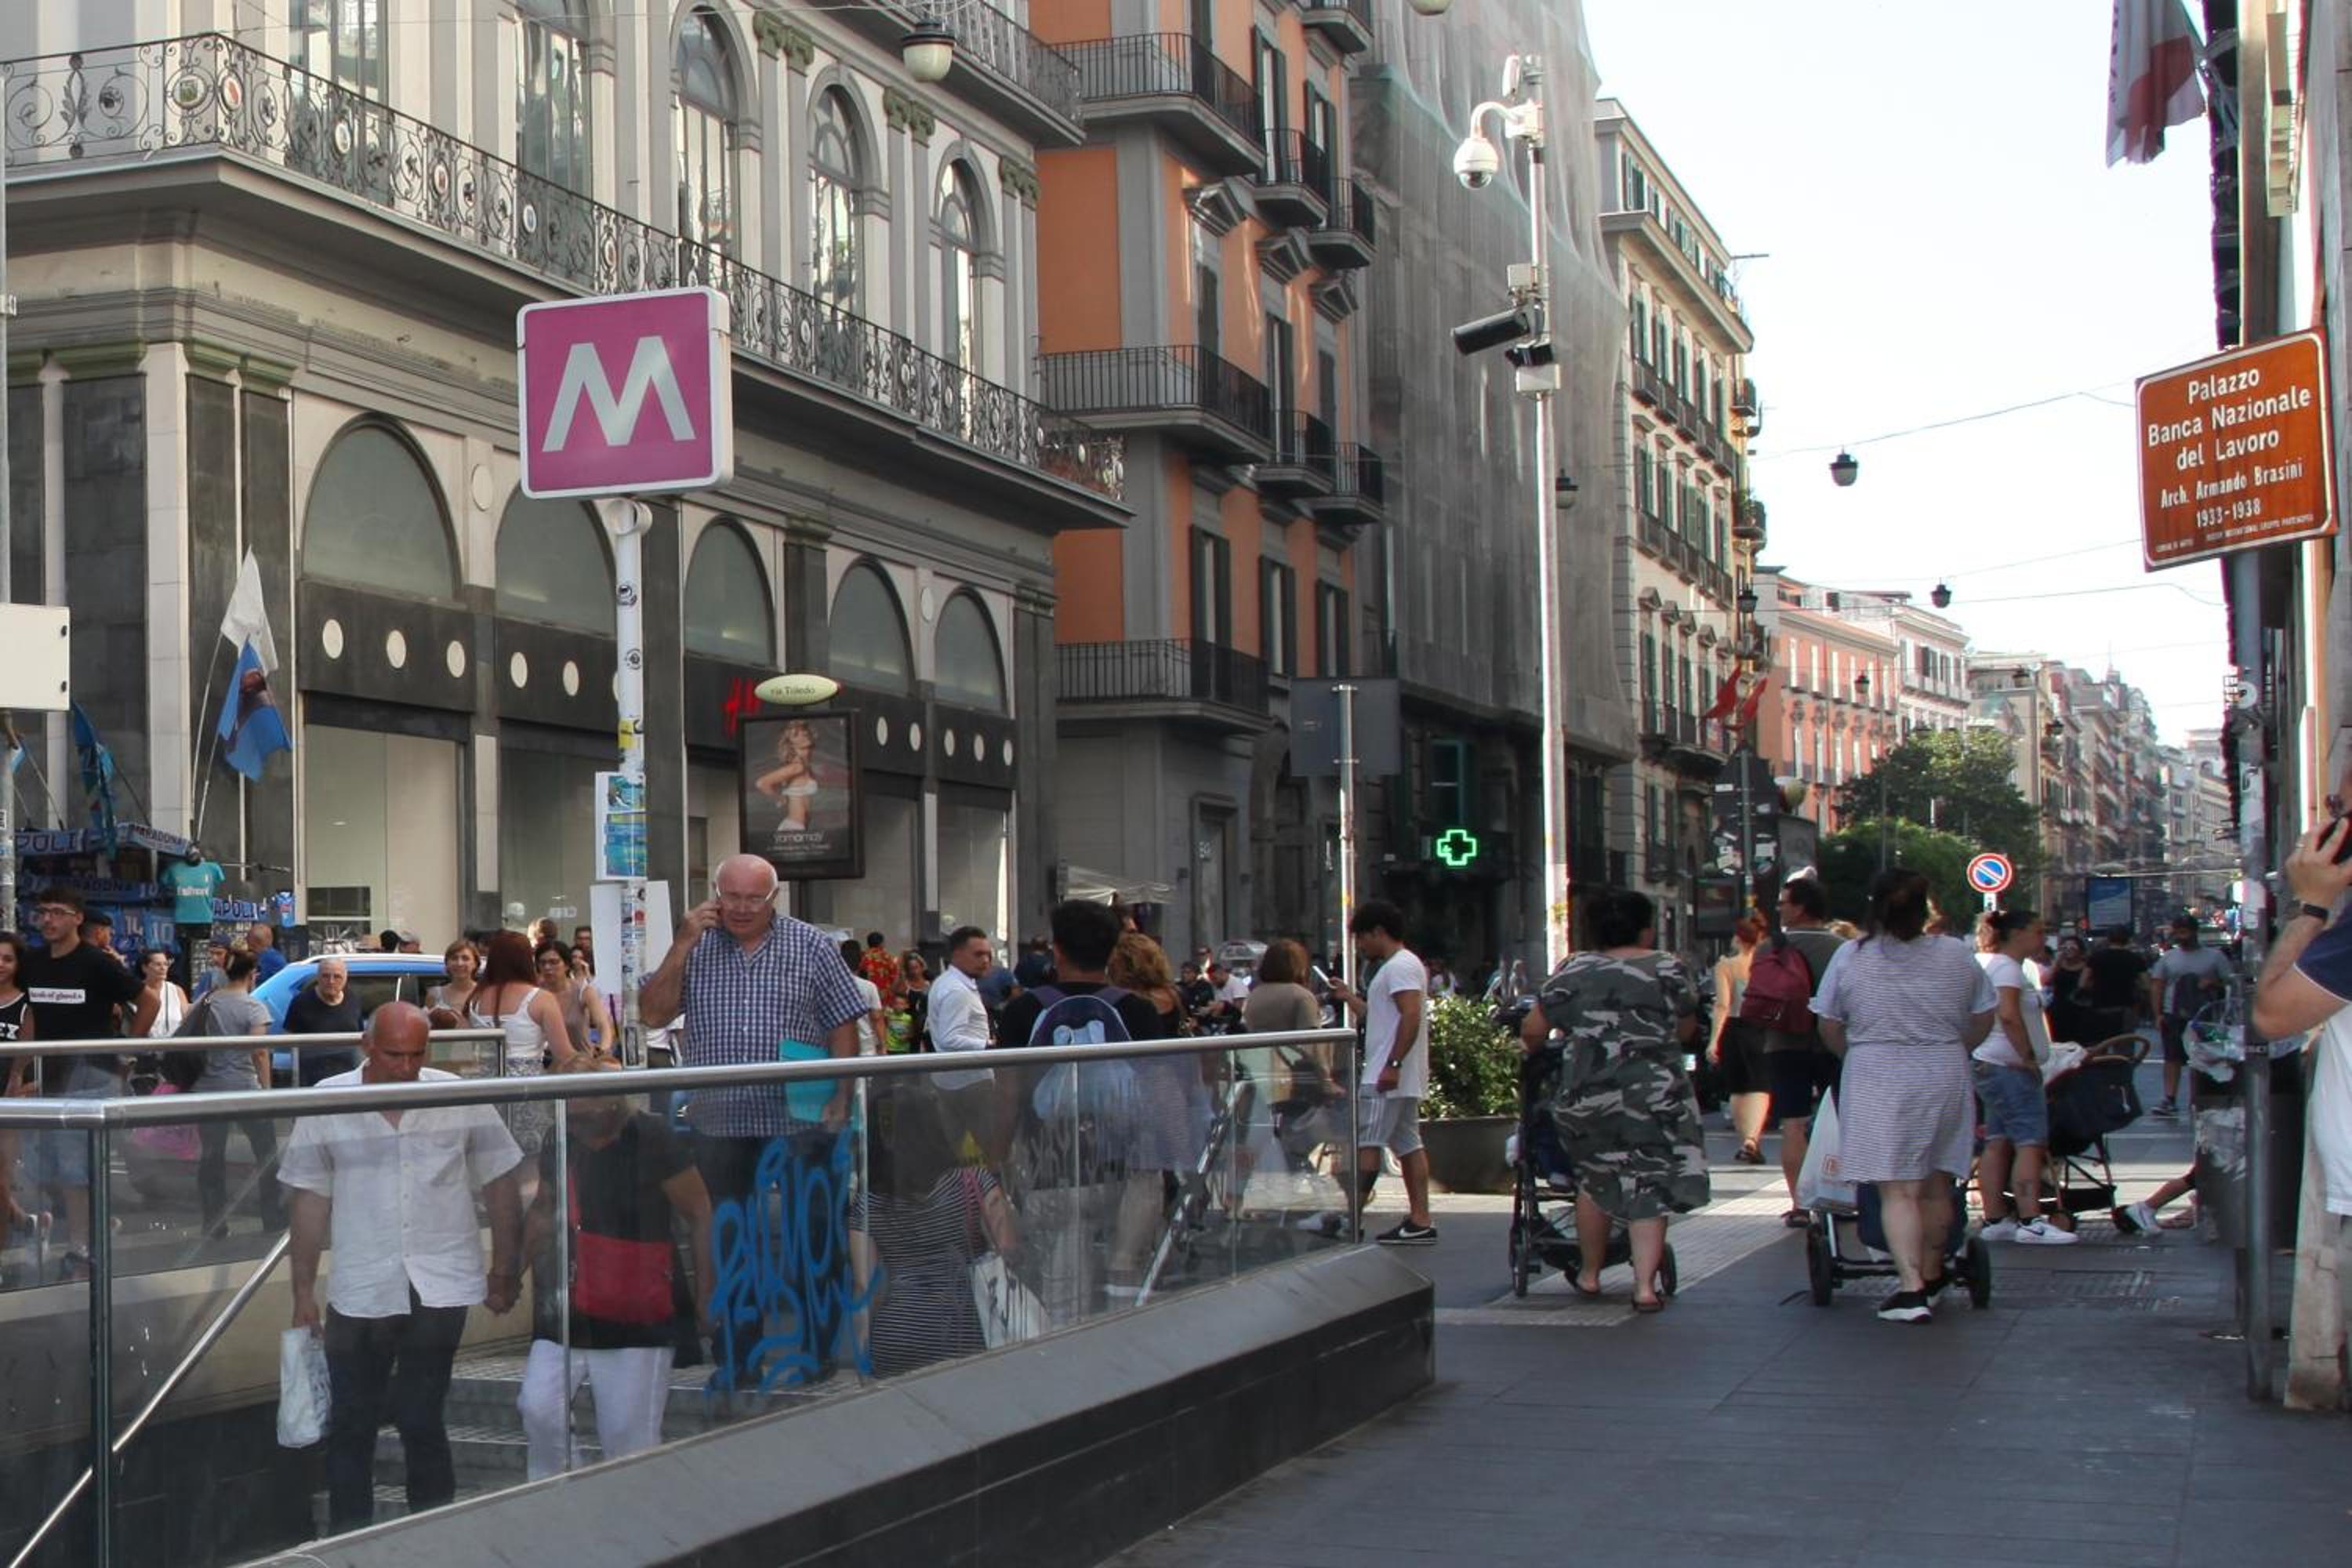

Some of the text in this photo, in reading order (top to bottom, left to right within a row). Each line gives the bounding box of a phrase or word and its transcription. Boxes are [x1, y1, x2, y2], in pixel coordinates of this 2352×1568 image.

[542, 335, 697, 452] M
[2188, 368, 2259, 404] Palazzo
[2148, 386, 2310, 447] Banca Nazionale
[2176, 430, 2279, 471] del Lavoro
[2161, 458, 2303, 509] Arch. Armando Brasini
[2196, 498, 2261, 528] 1933-1938
